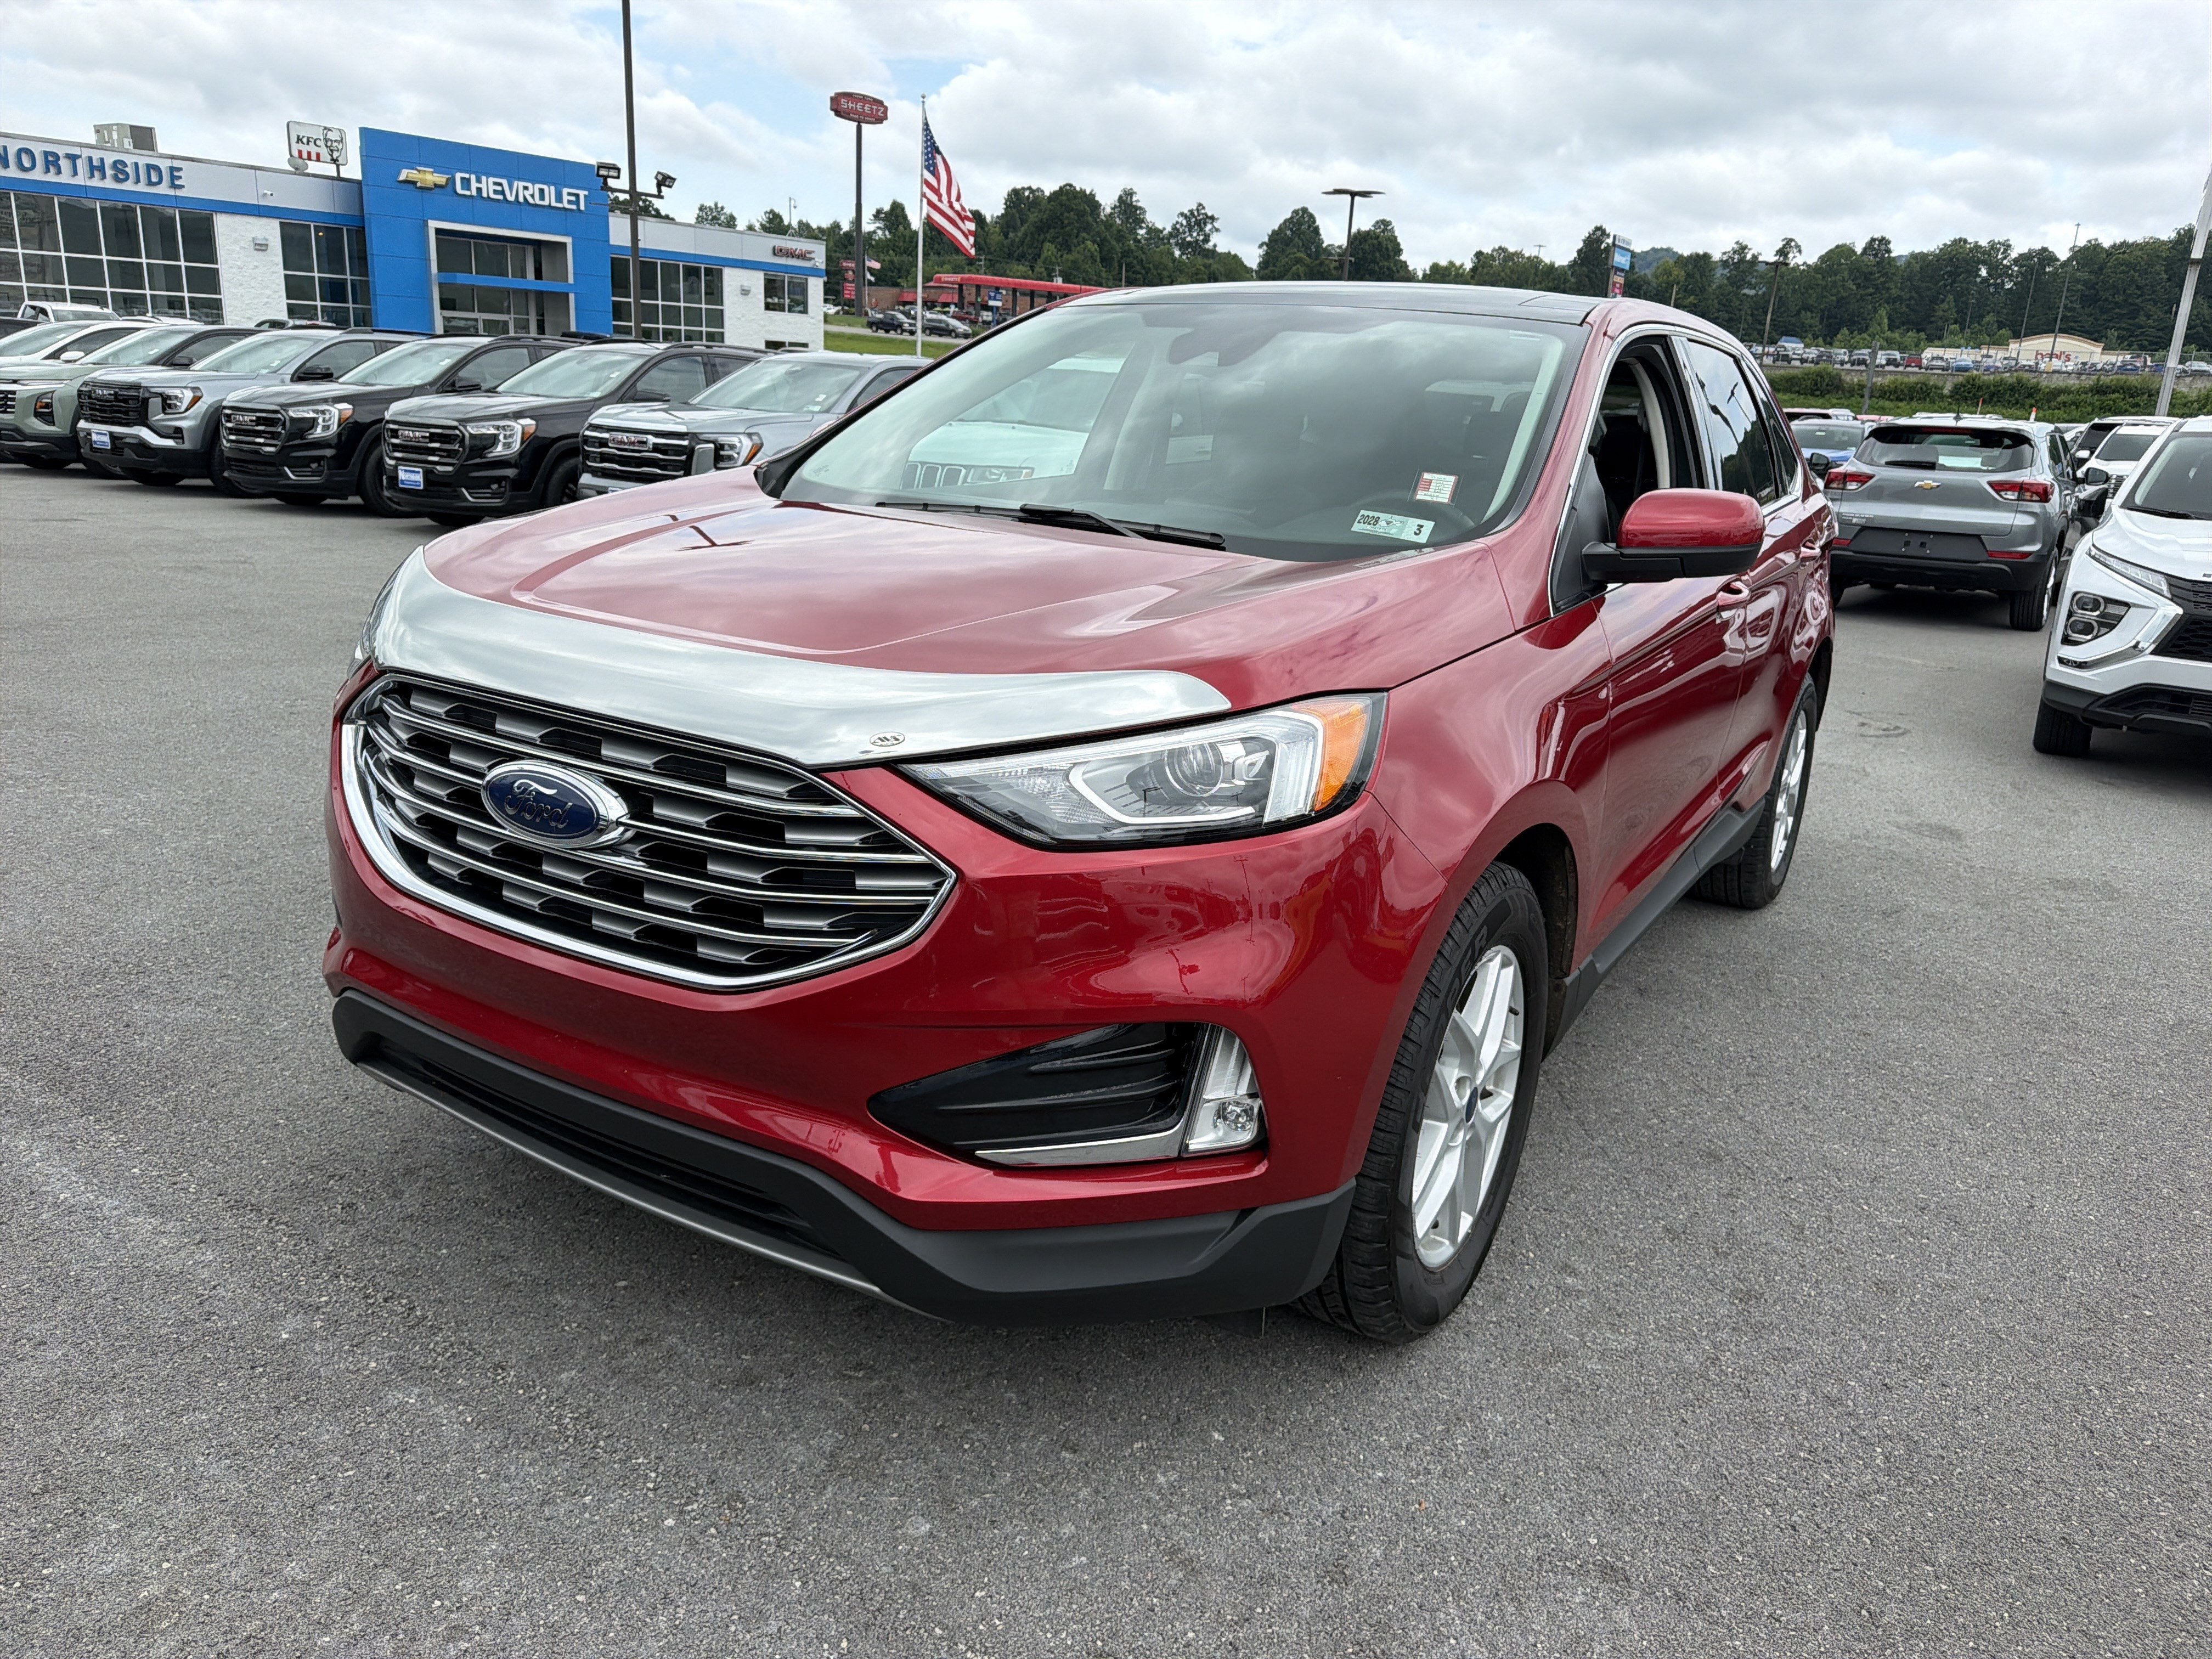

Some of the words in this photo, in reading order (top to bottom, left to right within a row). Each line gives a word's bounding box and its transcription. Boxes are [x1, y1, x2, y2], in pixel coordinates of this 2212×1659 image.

[840, 99, 884, 116] SHEETZ
[296, 134, 321, 148] KFC
[455, 172, 589, 211] CHEVROLET
[773, 245, 816, 261] GMC
[1357, 514, 1380, 526] 2028
[1413, 524, 1425, 536] 3
[504, 779, 573, 829] Ford
